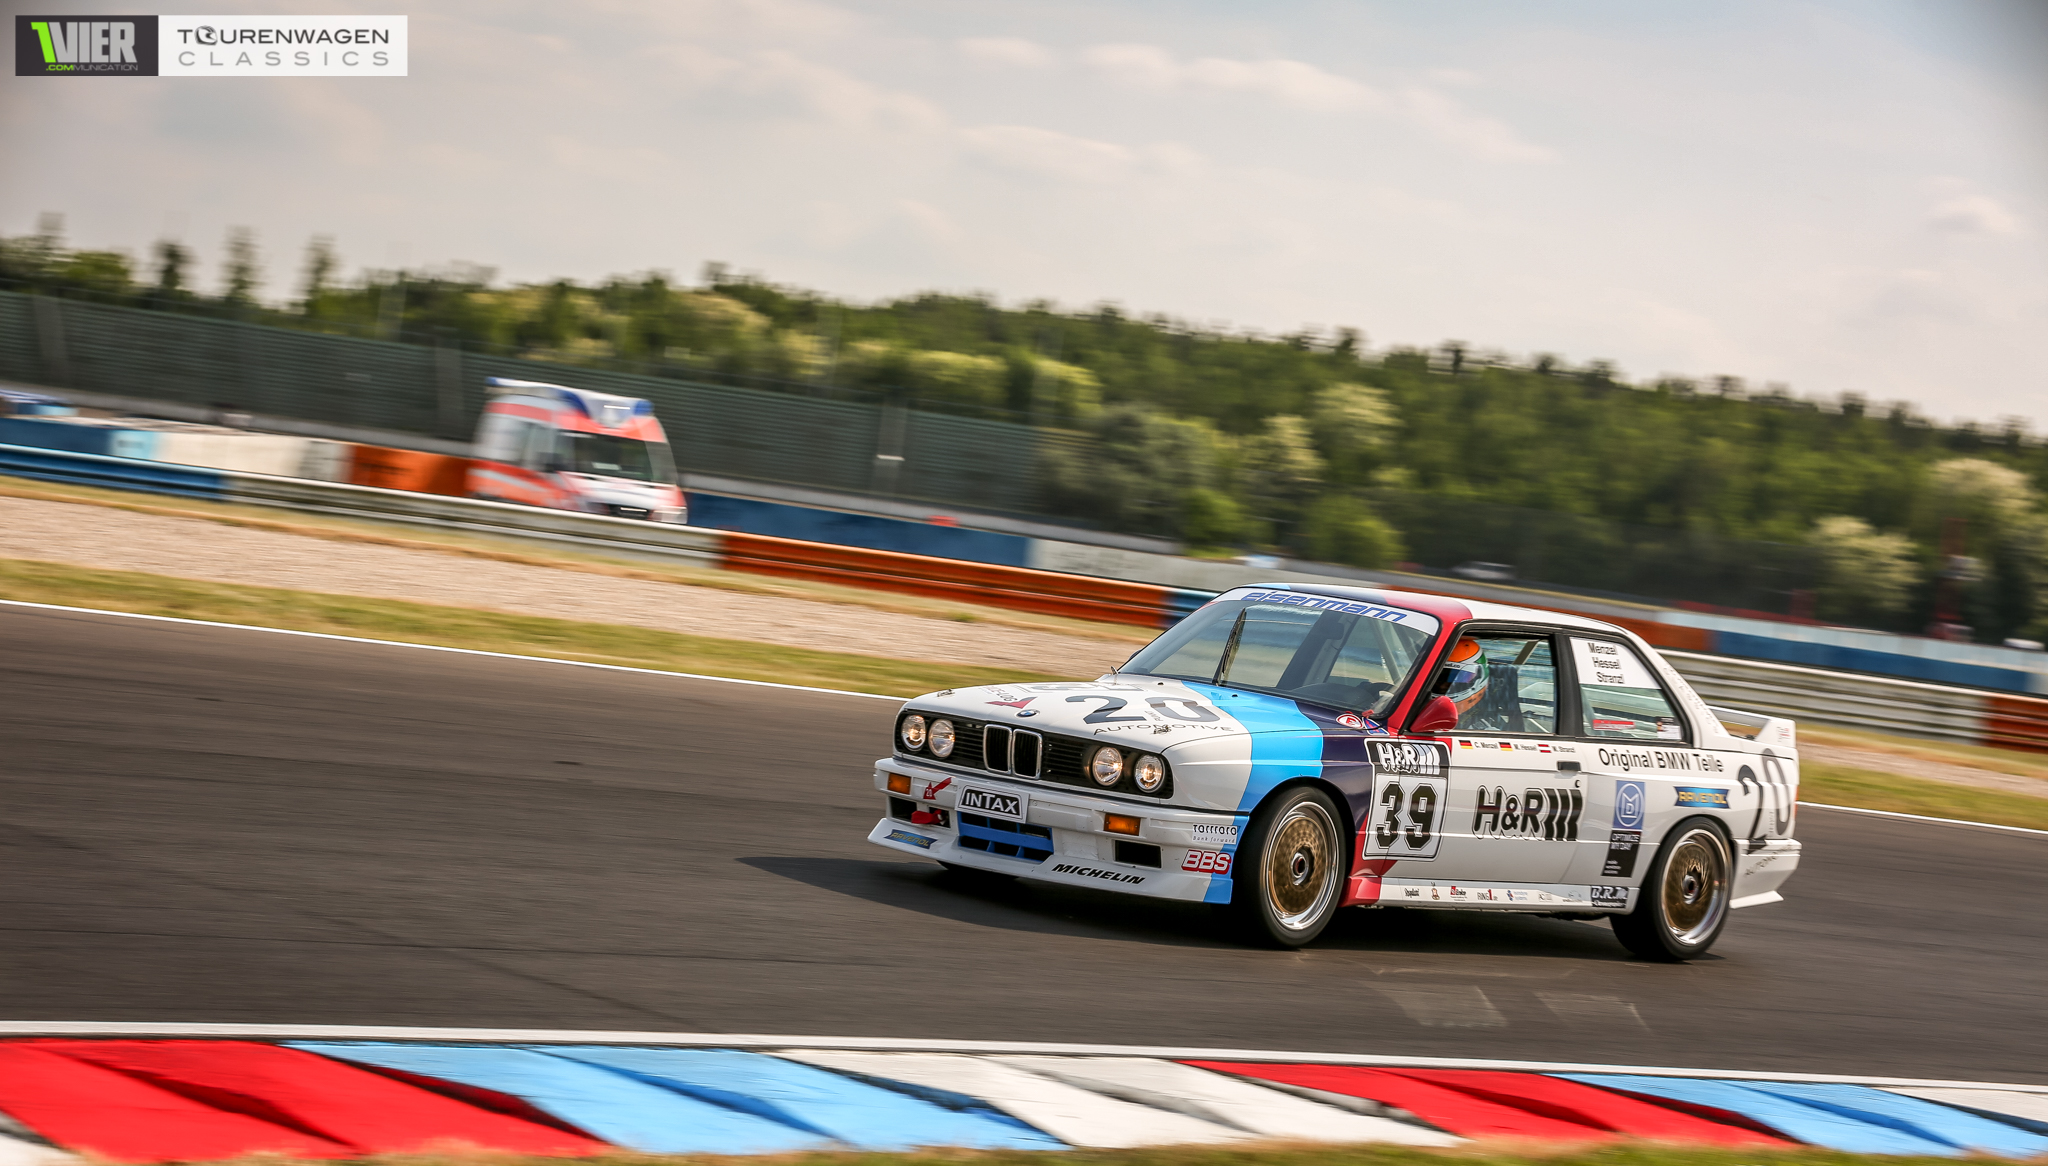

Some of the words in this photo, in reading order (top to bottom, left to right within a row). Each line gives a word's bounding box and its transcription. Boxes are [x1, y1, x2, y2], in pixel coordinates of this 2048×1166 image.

[1241, 590, 1408, 623] eisenmann
[1587, 642, 1618, 655] Menzel
[1592, 657, 1621, 670] Hessel
[1599, 748, 1653, 771] Original
[1655, 751, 1690, 770] BMW
[1692, 754, 1724, 772] Teile
[966, 792, 1018, 814] INTAX
[1375, 780, 1438, 849] 39
[890, 832, 931, 847] RAVENOL
[1182, 850, 1231, 871] BBS
[1052, 863, 1146, 885] MICHELIN
